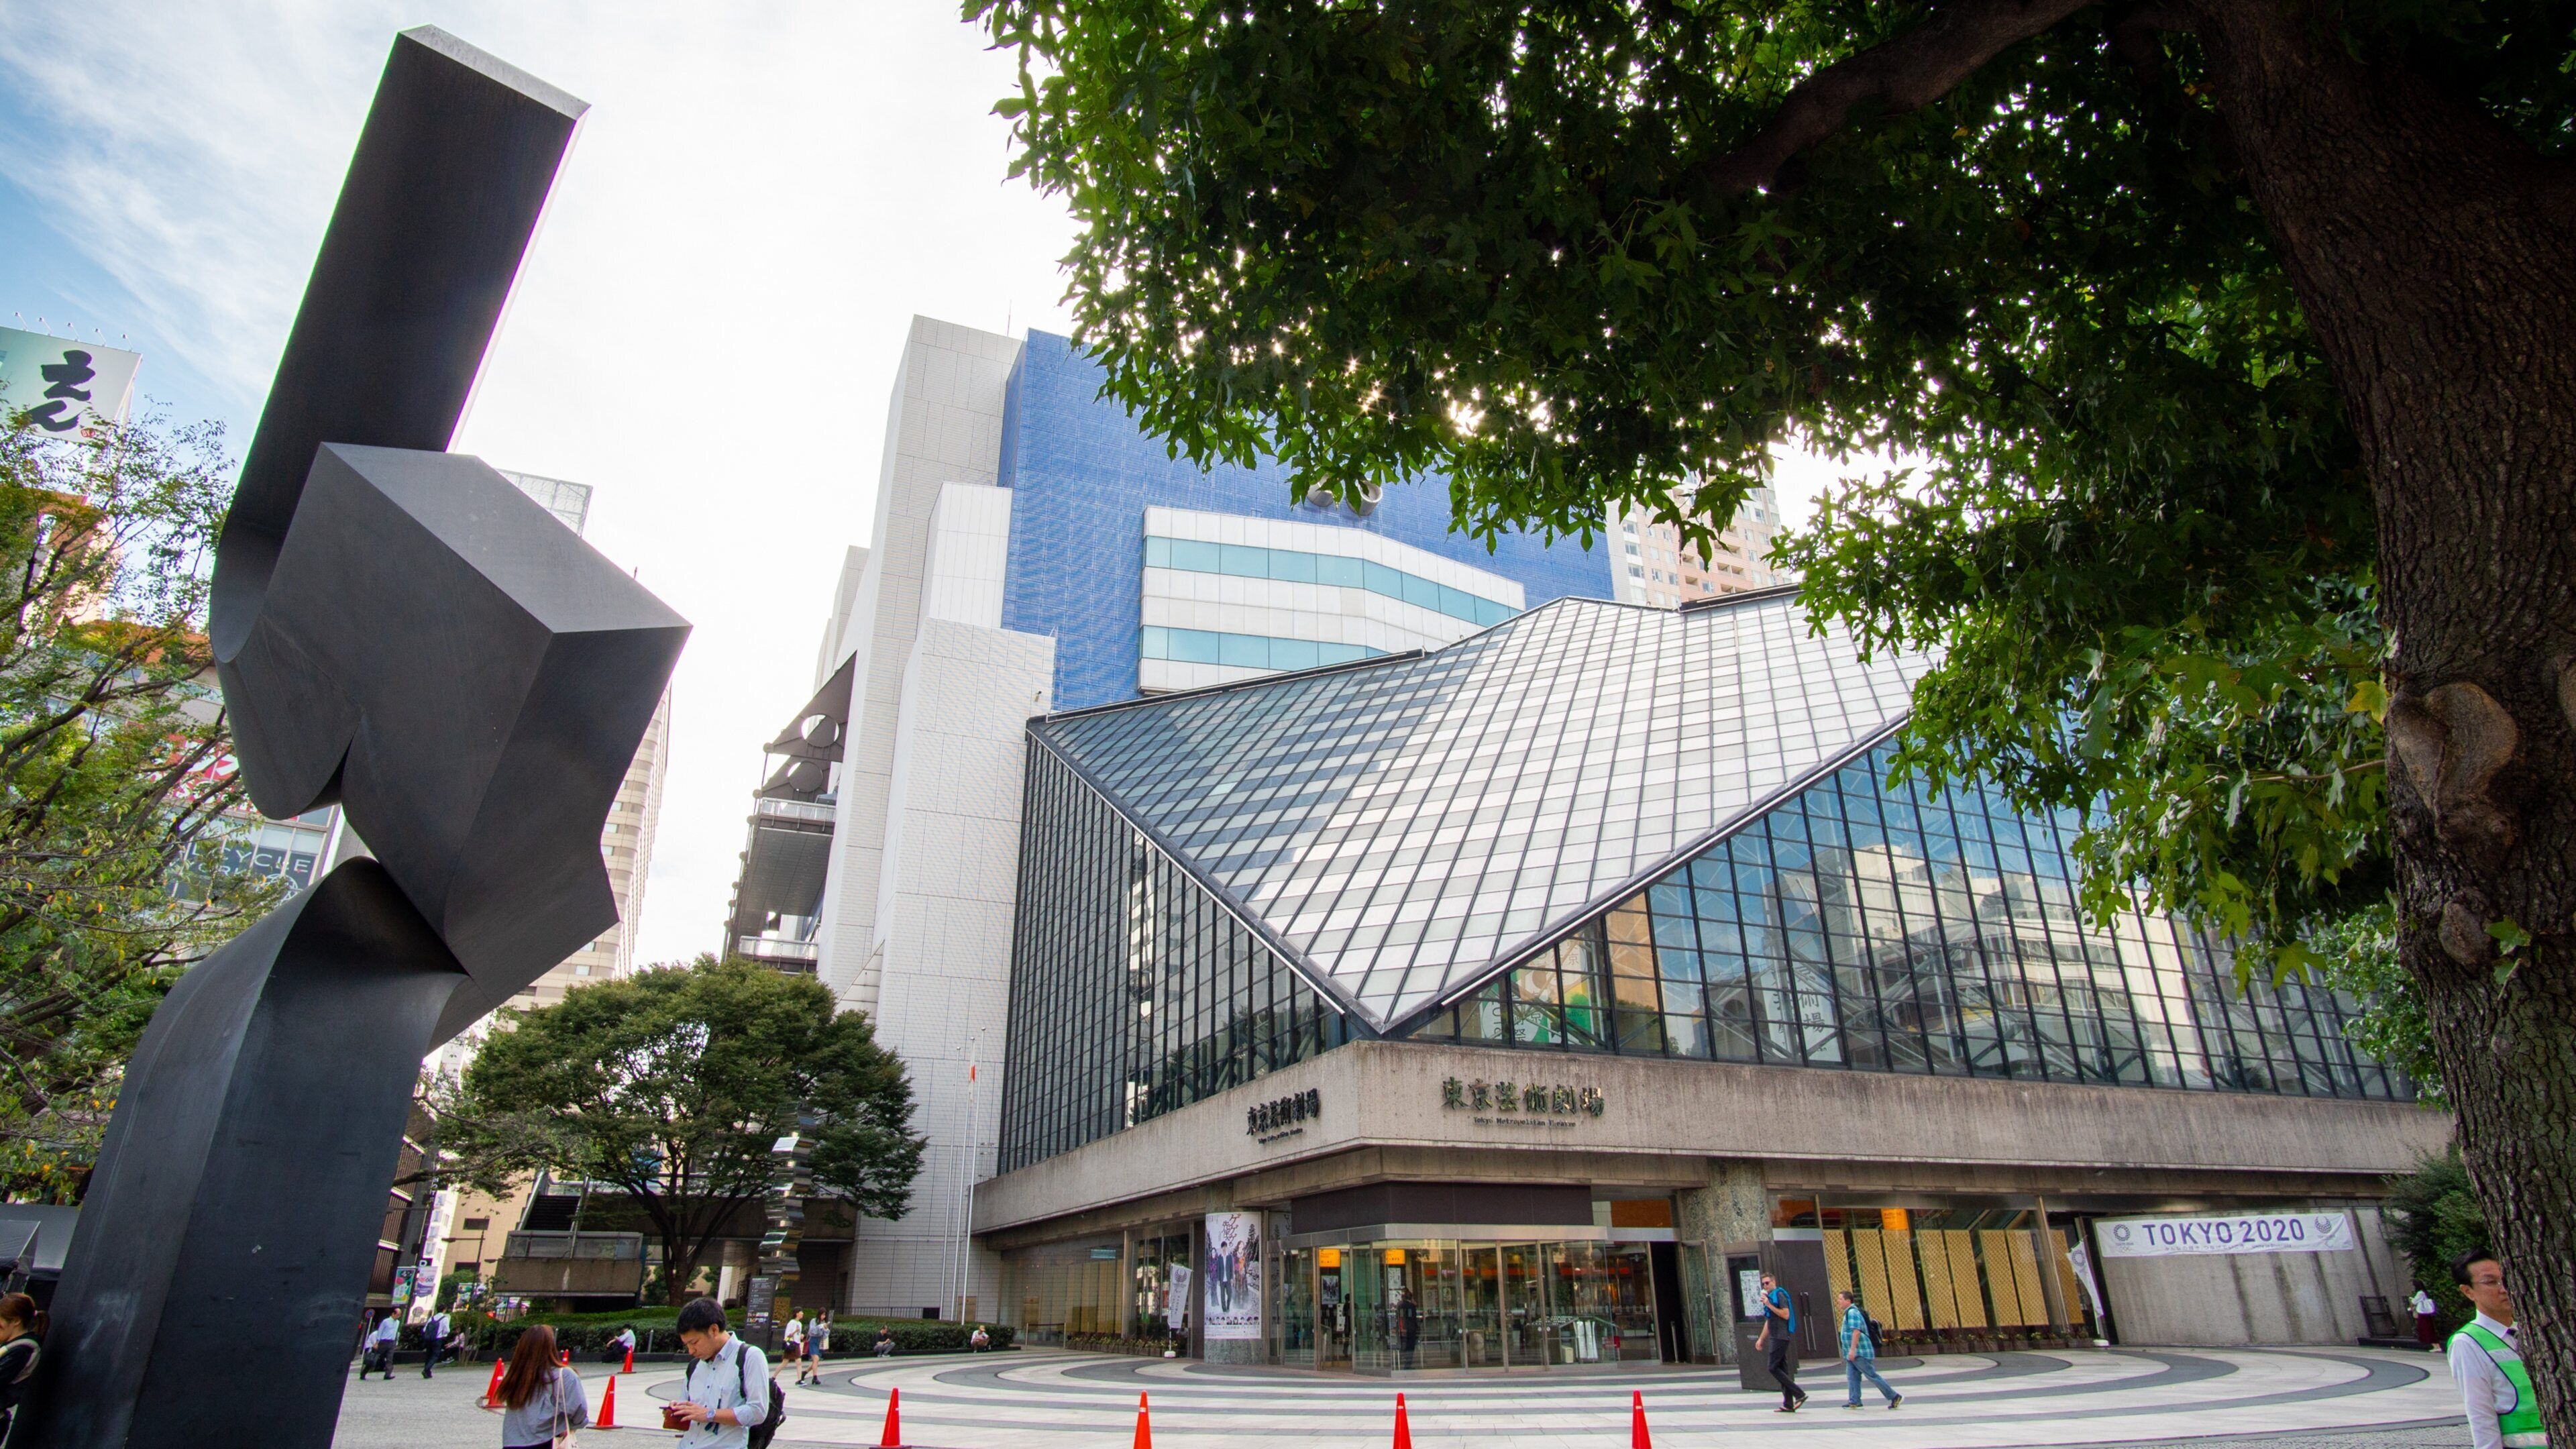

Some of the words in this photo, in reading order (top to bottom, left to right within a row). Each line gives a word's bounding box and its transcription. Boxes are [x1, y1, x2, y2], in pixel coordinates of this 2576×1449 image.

[25, 350, 96, 432] えん
[1442, 1077, 1605, 1117] 東京芸術劇場
[1474, 1116, 1493, 1125] Tokyo
[1497, 1117, 1546, 1126] Metropolitan
[2142, 1222, 2233, 1246] TOKYO
[2239, 1218, 2305, 1243] 2020
